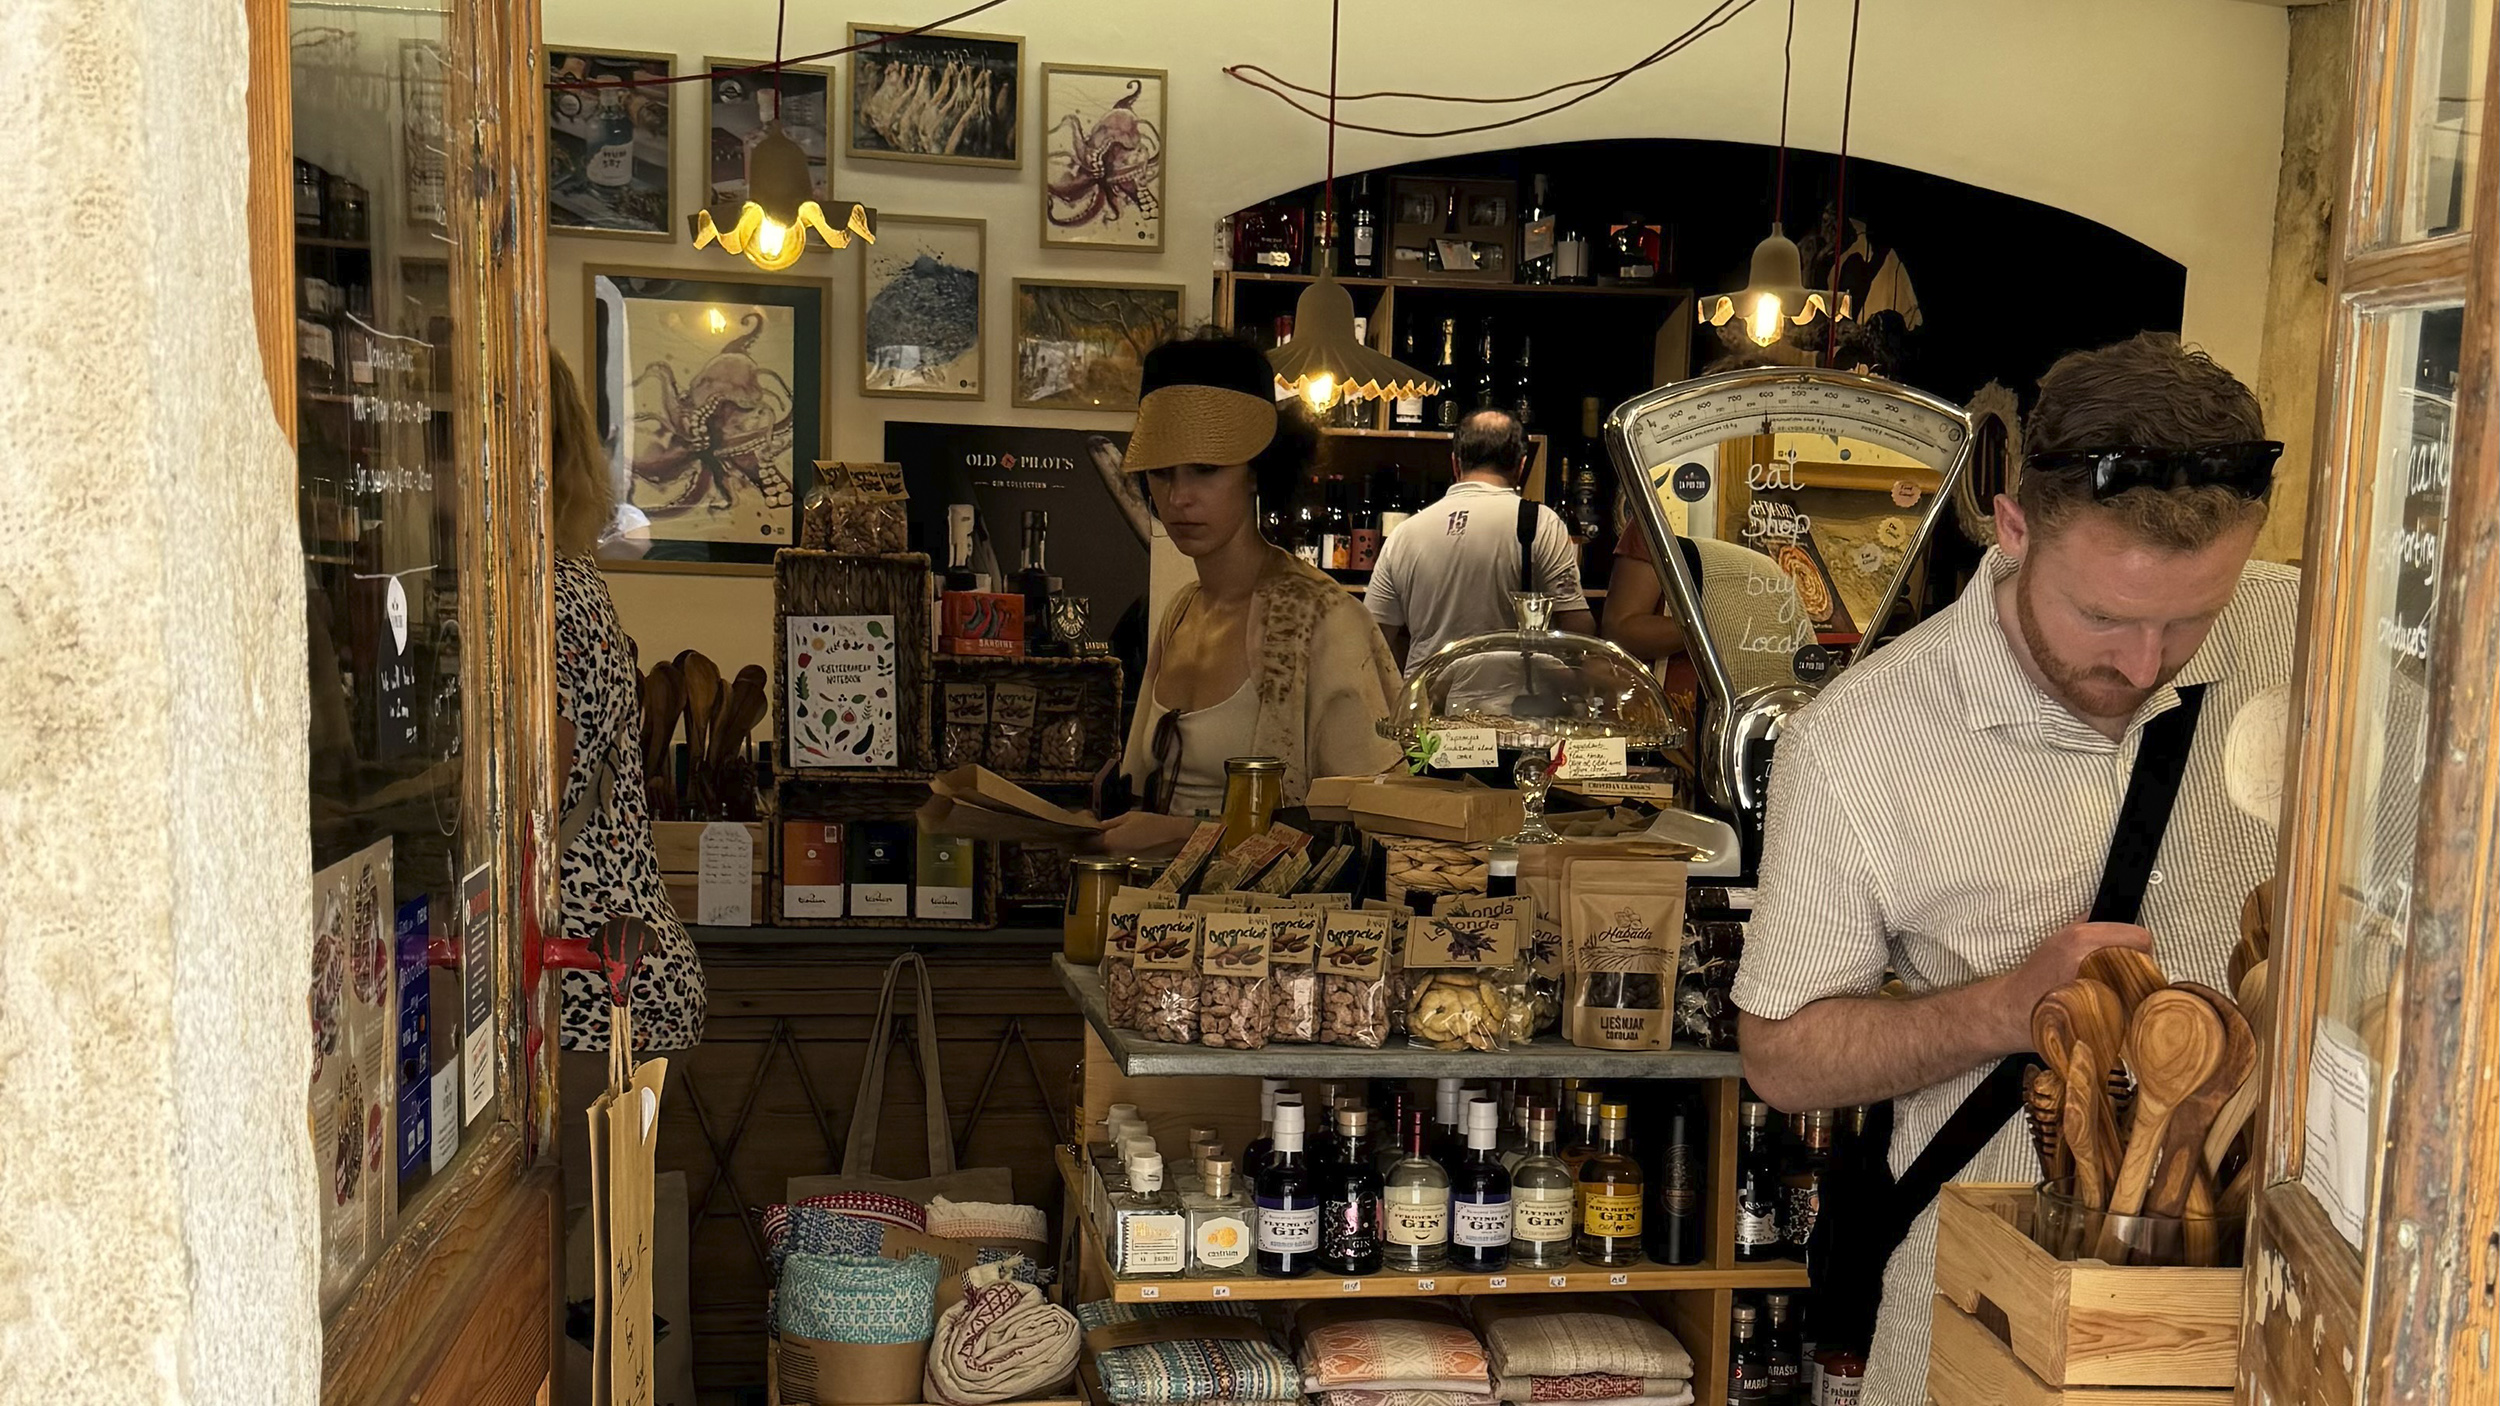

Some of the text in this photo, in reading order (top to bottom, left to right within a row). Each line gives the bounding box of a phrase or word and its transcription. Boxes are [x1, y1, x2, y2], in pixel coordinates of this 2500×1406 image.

[965, 453, 997, 467] OLD
[1745, 444, 1805, 490] eat
[1447, 510, 1470, 532] 15
[1742, 504, 1811, 549] Shop
[1746, 563, 1797, 624] buy
[1740, 616, 1807, 657] Local
[1600, 1014, 1645, 1031] LJEŠNJAK
[1527, 1216, 1565, 1226] GIN
[1599, 1211, 1635, 1221] GIN
[1401, 1219, 1440, 1229] GIN
[1469, 1221, 1506, 1230] GIN
[1272, 1226, 1310, 1236] GIN
[1352, 1240, 1370, 1248] GIN
[1768, 1364, 1798, 1376] ARAŠKA
